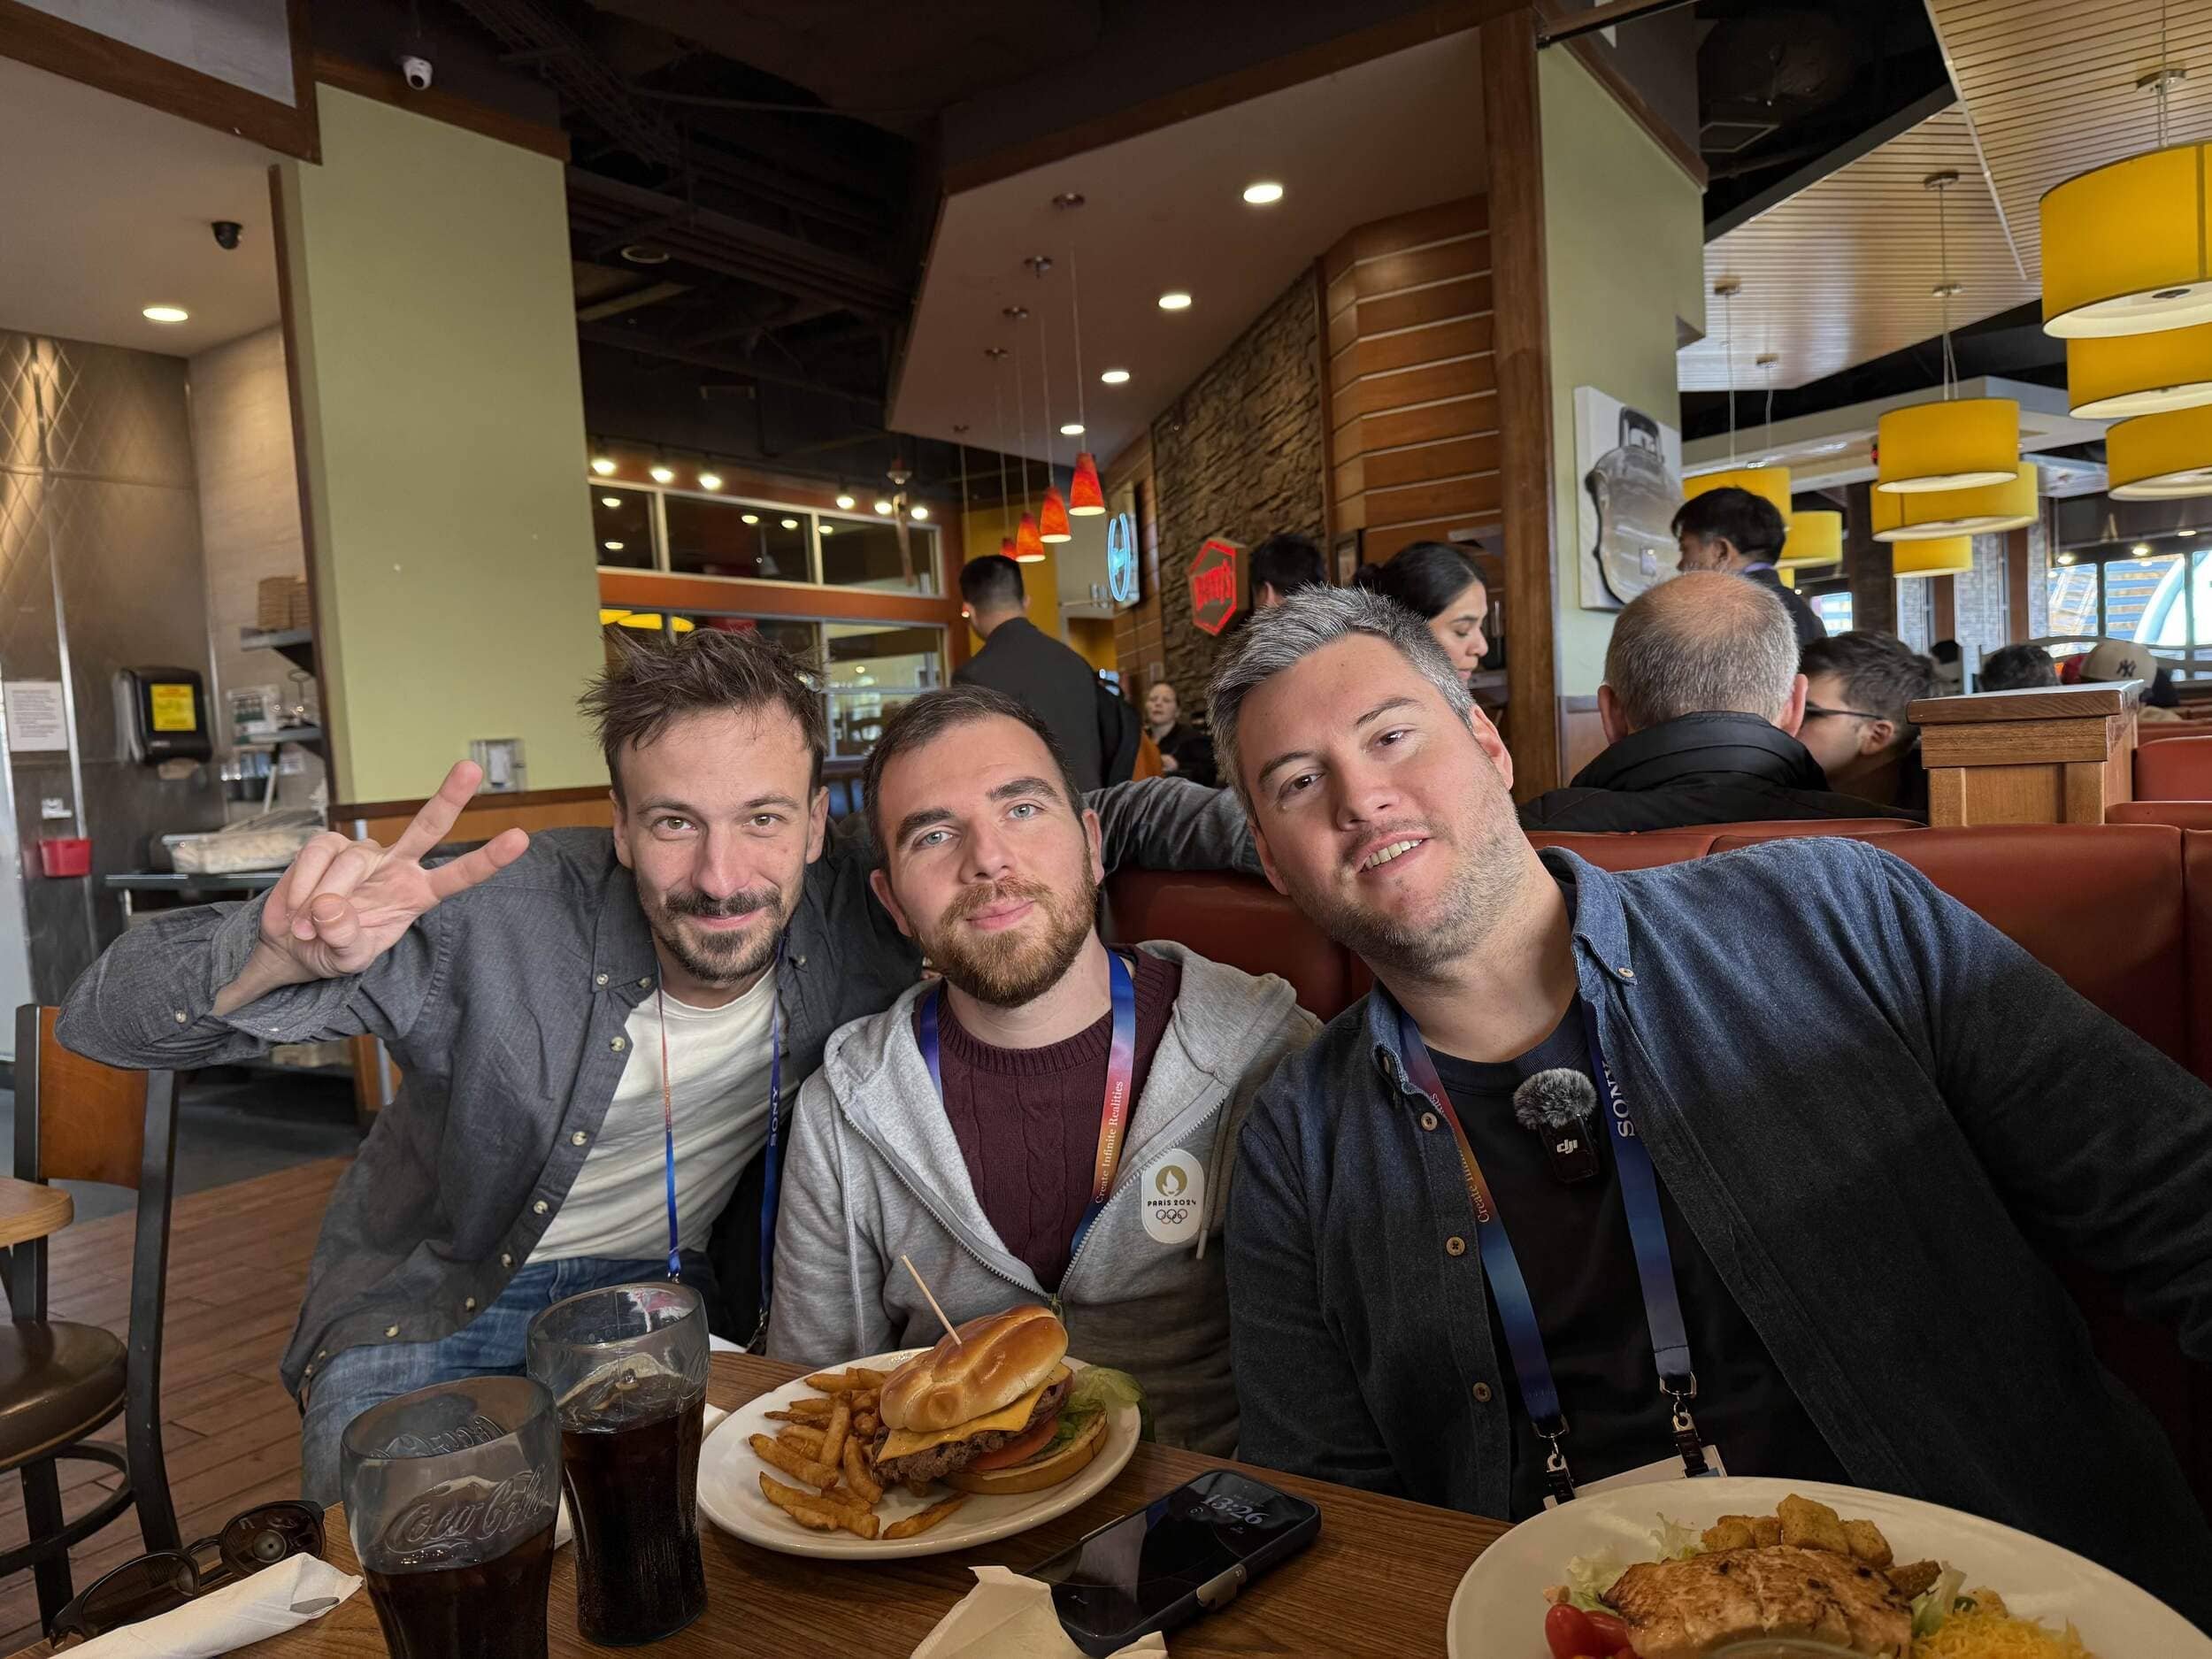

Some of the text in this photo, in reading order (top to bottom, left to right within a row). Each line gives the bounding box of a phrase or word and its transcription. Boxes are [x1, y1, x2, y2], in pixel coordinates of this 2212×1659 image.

[1094, 1080, 1124, 1203] Create Infinite Realities
[1470, 1183, 1490, 1224] Create
[1201, 1494, 1271, 1525] 13:26
